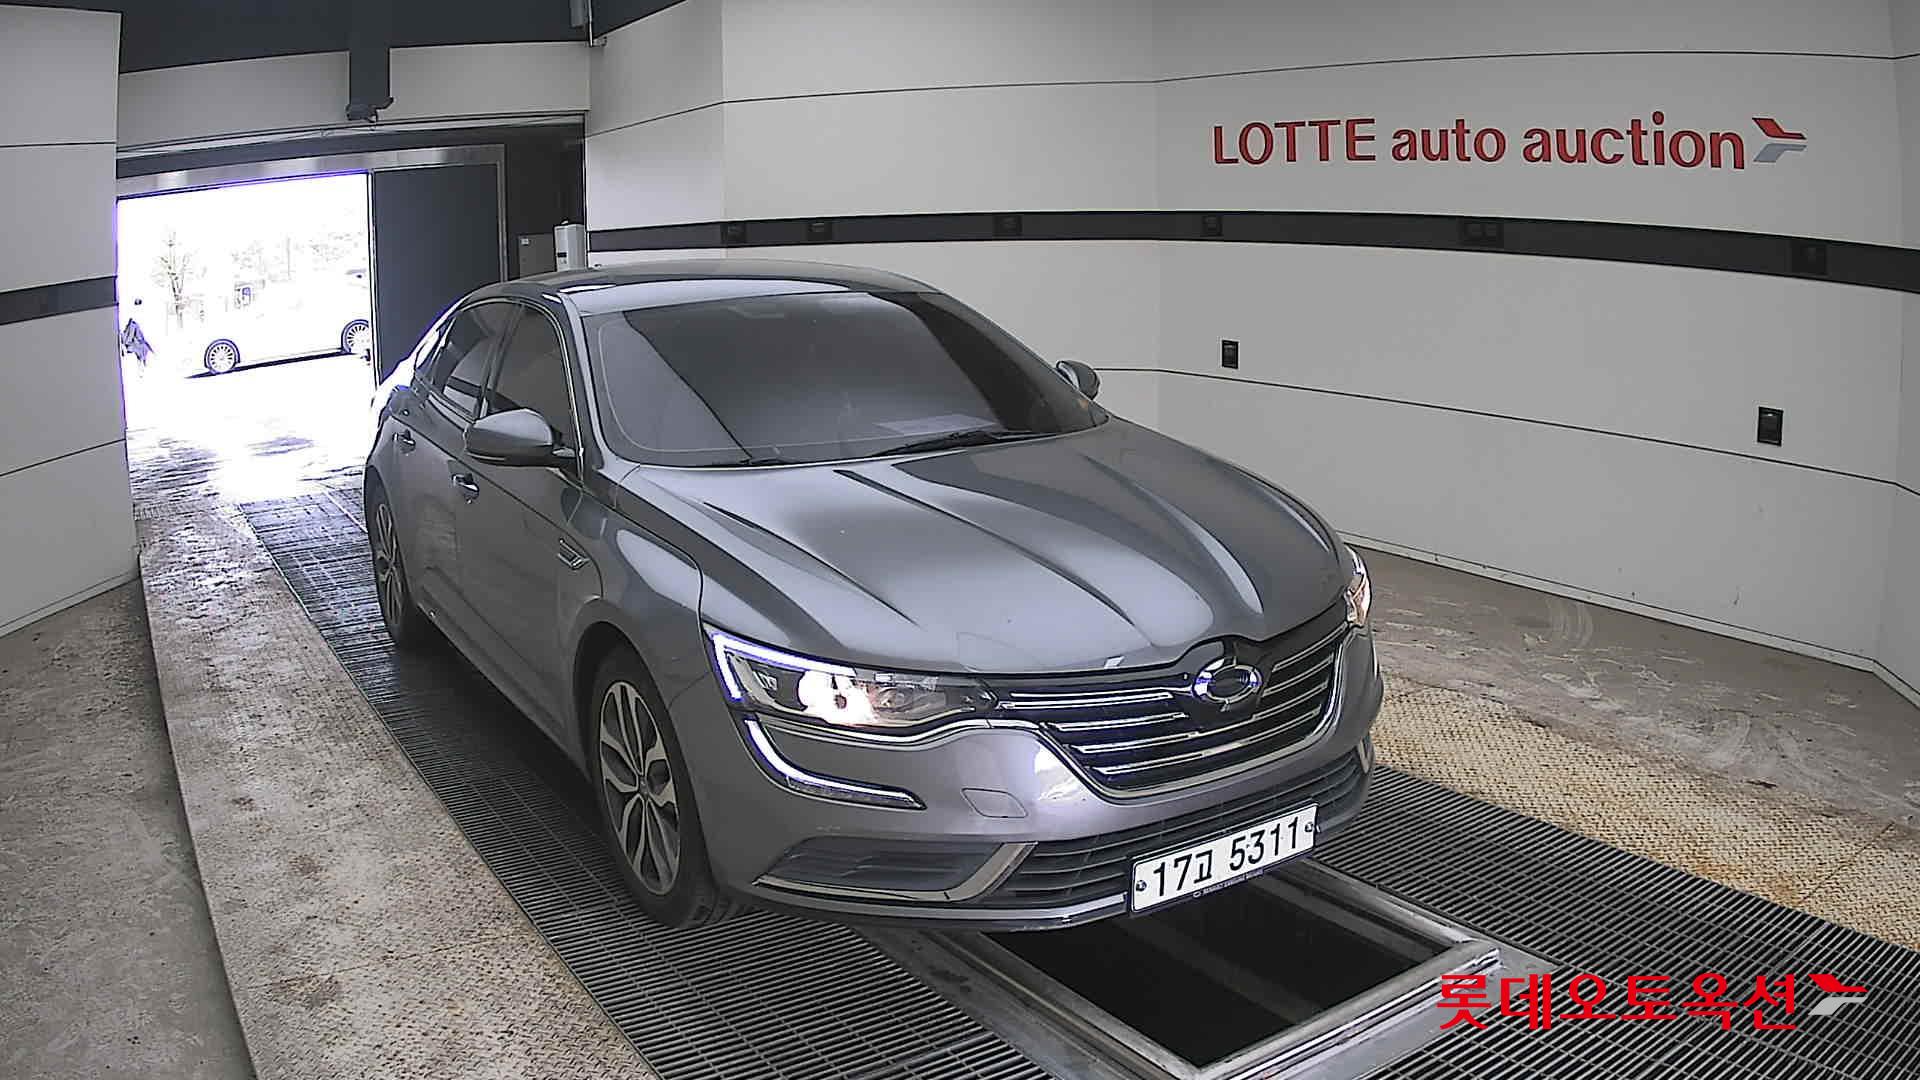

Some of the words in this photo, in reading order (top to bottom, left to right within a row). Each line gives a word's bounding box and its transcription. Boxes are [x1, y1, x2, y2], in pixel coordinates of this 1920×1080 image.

[1213, 118, 1376, 165] LOTTE
[1391, 118, 1507, 163] auto
[1522, 110, 1745, 169] auction
[1152, 848, 1214, 897] 17고
[1228, 816, 1299, 872] 5311
